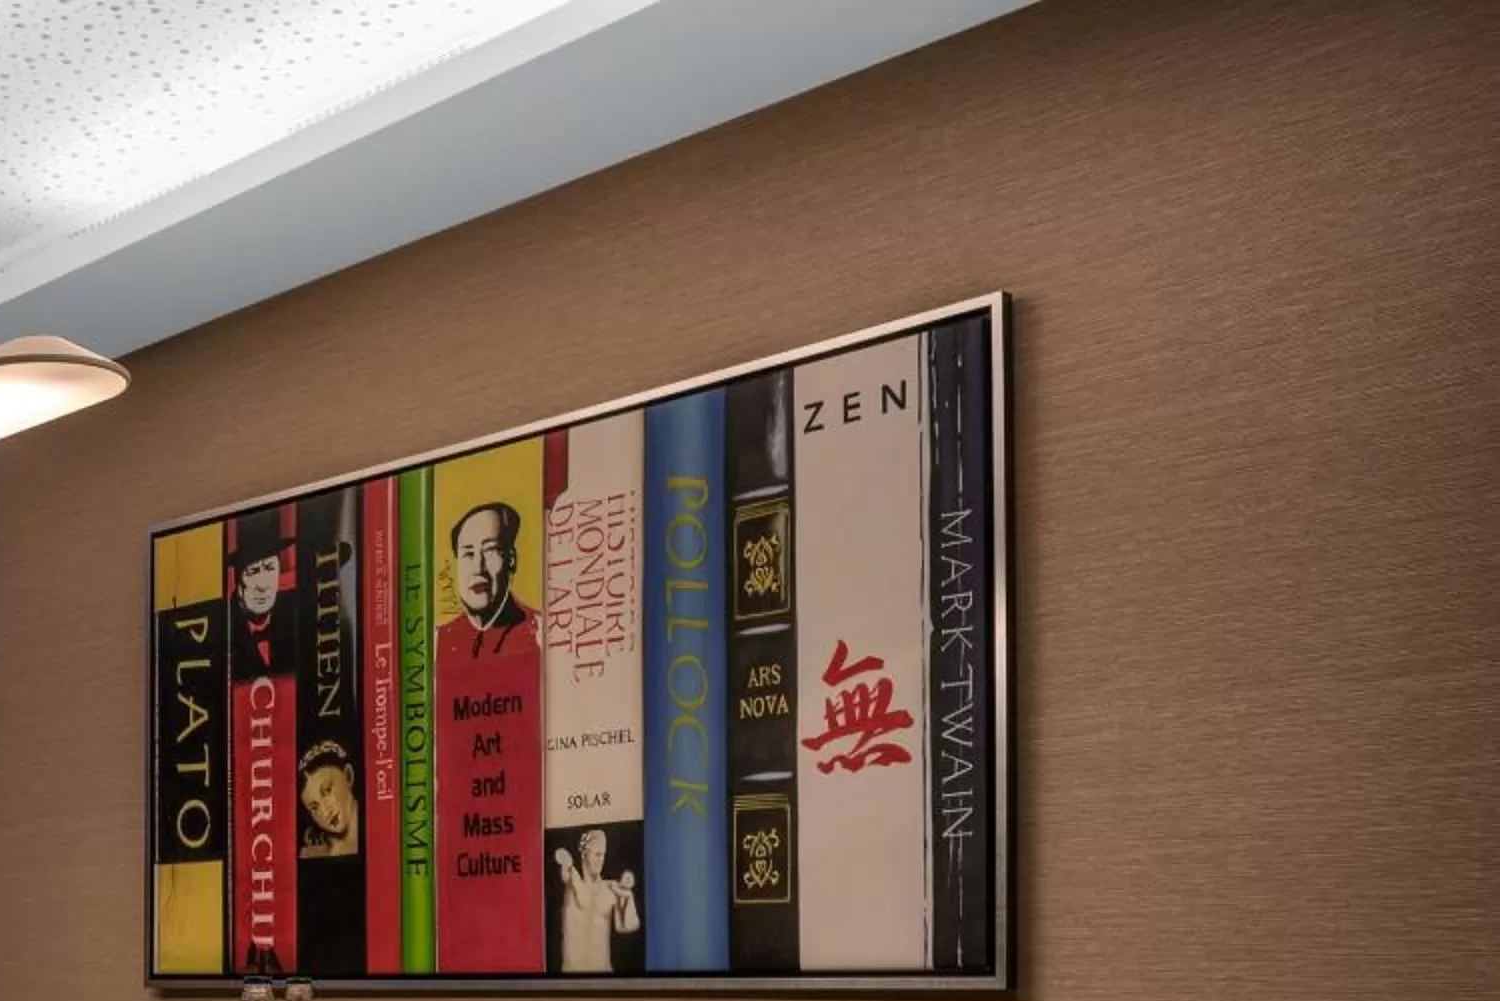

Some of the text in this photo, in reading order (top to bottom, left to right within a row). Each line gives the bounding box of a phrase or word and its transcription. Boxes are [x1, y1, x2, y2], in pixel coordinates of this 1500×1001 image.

[802, 380, 909, 434] ZEN
[573, 499, 605, 684] MONDIALE
[316, 542, 342, 719] TITIEN
[374, 641, 393, 672] Le
[666, 477, 709, 817] POLLOCK
[747, 664, 781, 688] ARS
[938, 508, 974, 842] MARK TWAIN
[452, 693, 523, 721] Modern
[739, 696, 789, 720] NOVA
[176, 615, 212, 849] PLATO
[472, 732, 503, 760] Art
[403, 619, 429, 876] SYMBOLISME
[471, 769, 506, 797] and
[567, 793, 611, 809] SOLAR
[463, 814, 514, 839] Mass
[457, 851, 522, 877] Culture
